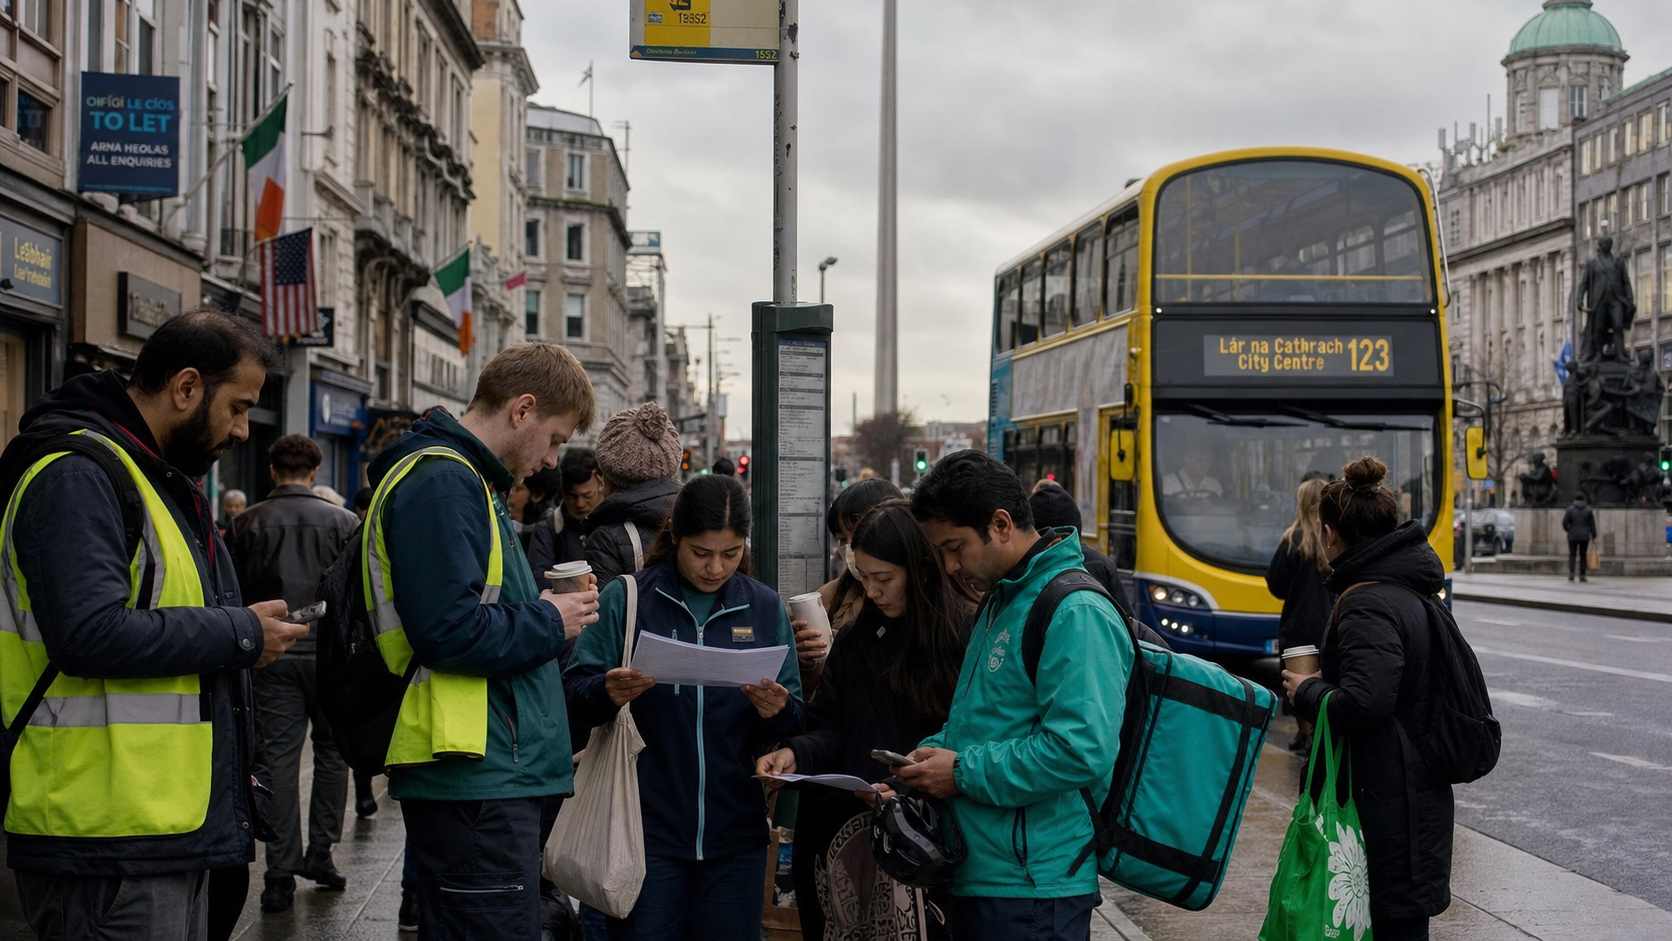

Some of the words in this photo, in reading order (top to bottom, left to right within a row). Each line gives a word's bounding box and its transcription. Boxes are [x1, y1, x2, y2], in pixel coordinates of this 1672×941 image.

[127, 97, 143, 110] LE
[144, 97, 175, 112] CÍOS
[89, 111, 124, 131] TO
[129, 112, 172, 133] LET
[90, 141, 122, 153] ARNA
[86, 154, 108, 165] ALL
[110, 155, 172, 169] ENQUIRIES
[1220, 337, 1246, 354] Lár
[1251, 341, 1269, 354] na
[1274, 337, 1343, 354] Cathrach
[1348, 338, 1390, 371] 123
[1238, 354, 1269, 373] City
[1274, 354, 1325, 370] Centre
